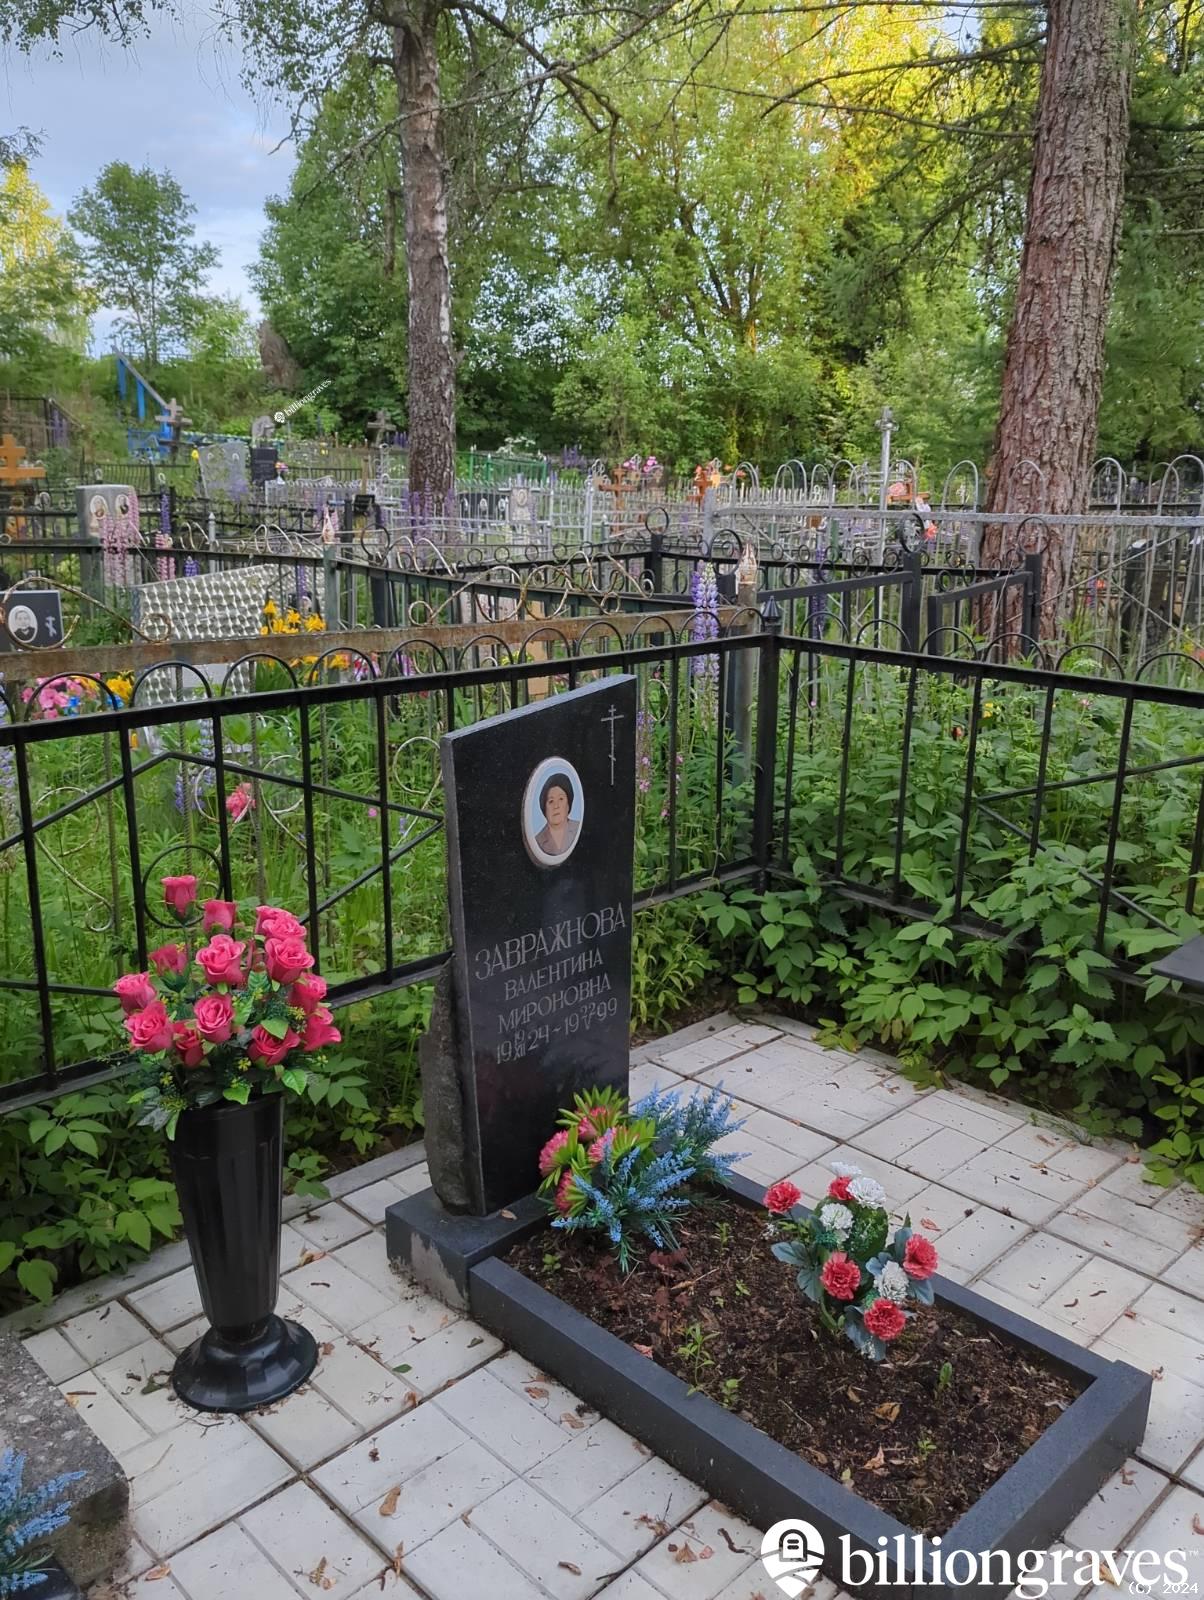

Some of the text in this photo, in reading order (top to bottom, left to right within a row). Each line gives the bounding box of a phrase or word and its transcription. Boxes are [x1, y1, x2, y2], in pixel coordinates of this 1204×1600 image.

[475, 902, 627, 980] ЗАВРАЖНОВА
[498, 973, 612, 1034] МИРОНОВНА
[504, 947, 604, 1001] ВАЛЕНТИНА
